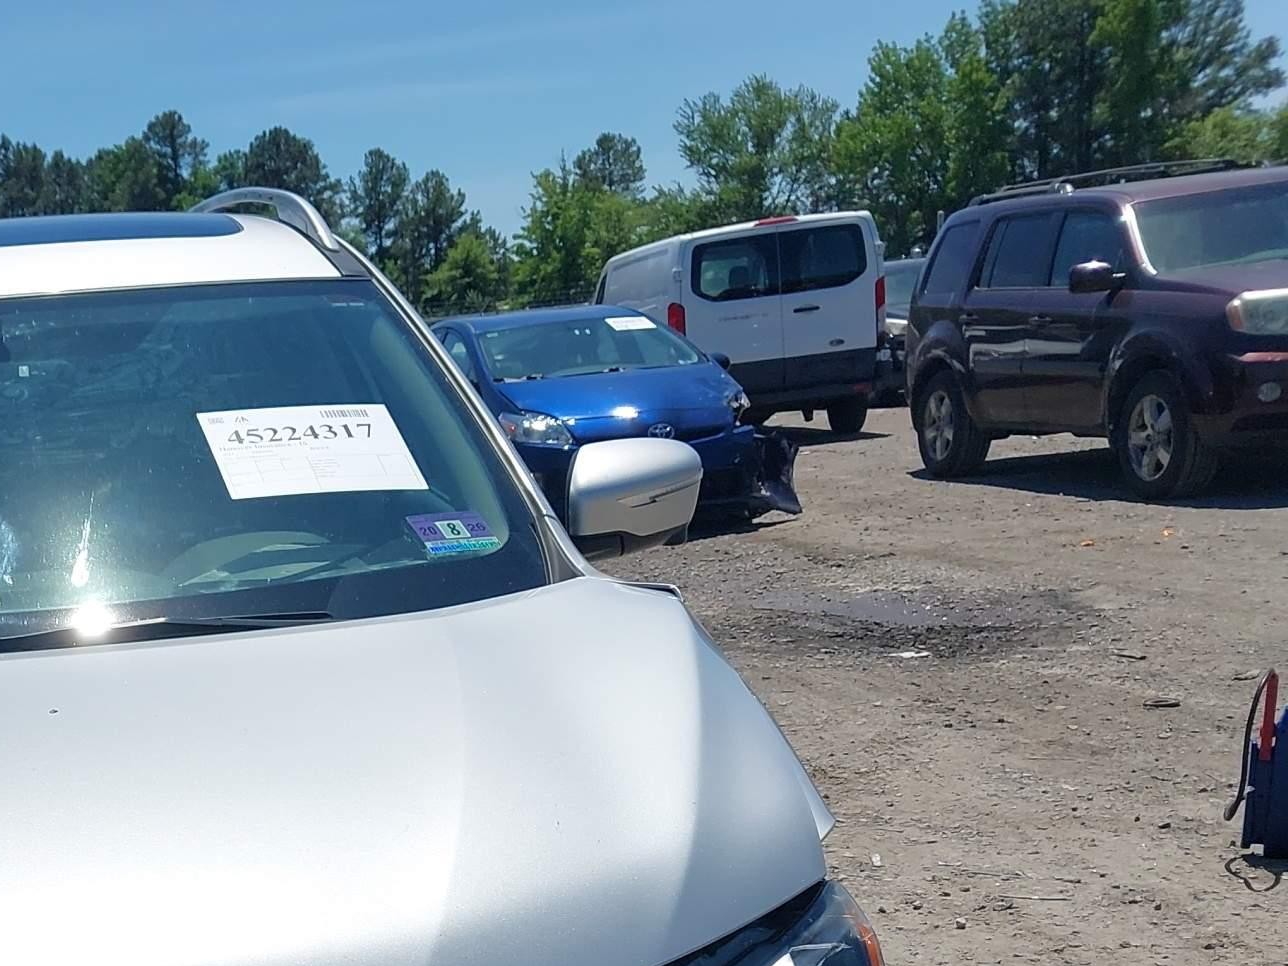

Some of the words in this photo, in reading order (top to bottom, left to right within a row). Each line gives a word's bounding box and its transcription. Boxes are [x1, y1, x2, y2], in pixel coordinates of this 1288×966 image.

[227, 422, 372, 444] 45224317
[419, 526, 438, 537] 20
[445, 522, 461, 537] 8
